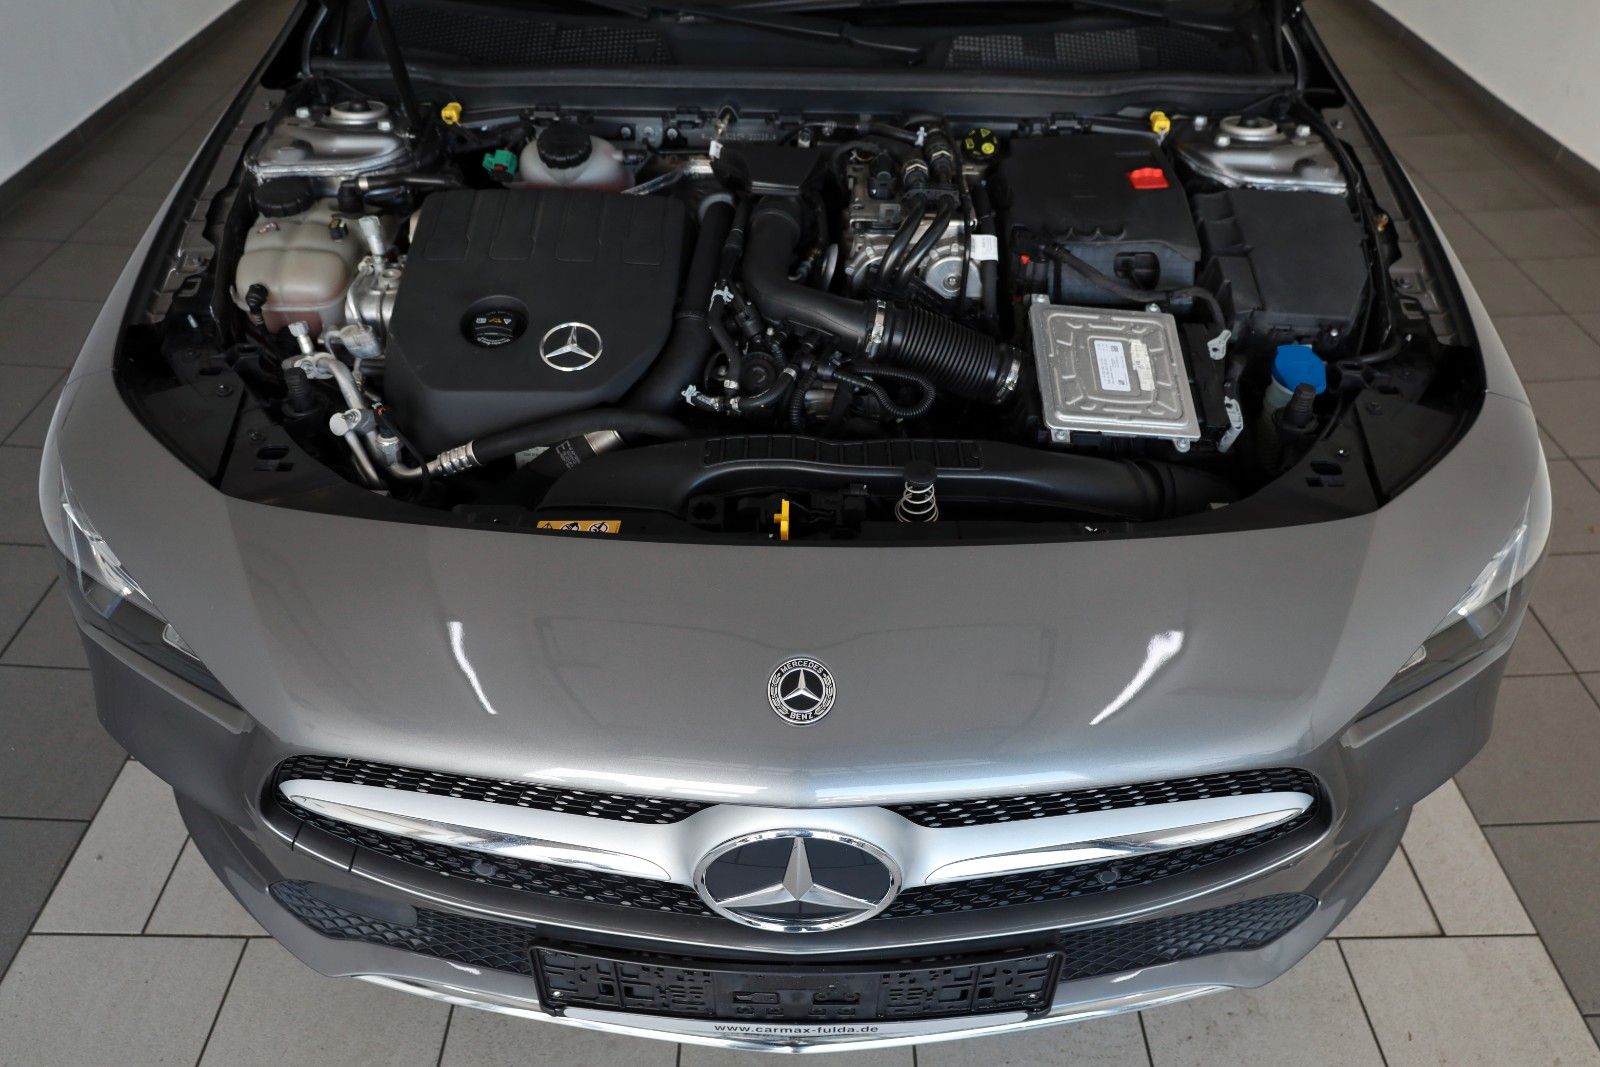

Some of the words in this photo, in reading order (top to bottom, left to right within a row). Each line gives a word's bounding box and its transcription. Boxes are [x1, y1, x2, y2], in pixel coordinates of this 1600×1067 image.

[780, 660, 824, 674] MERCEDES
[789, 711, 814, 720] BENZ
[714, 1023, 878, 1034] www.carmax-fulda.de
